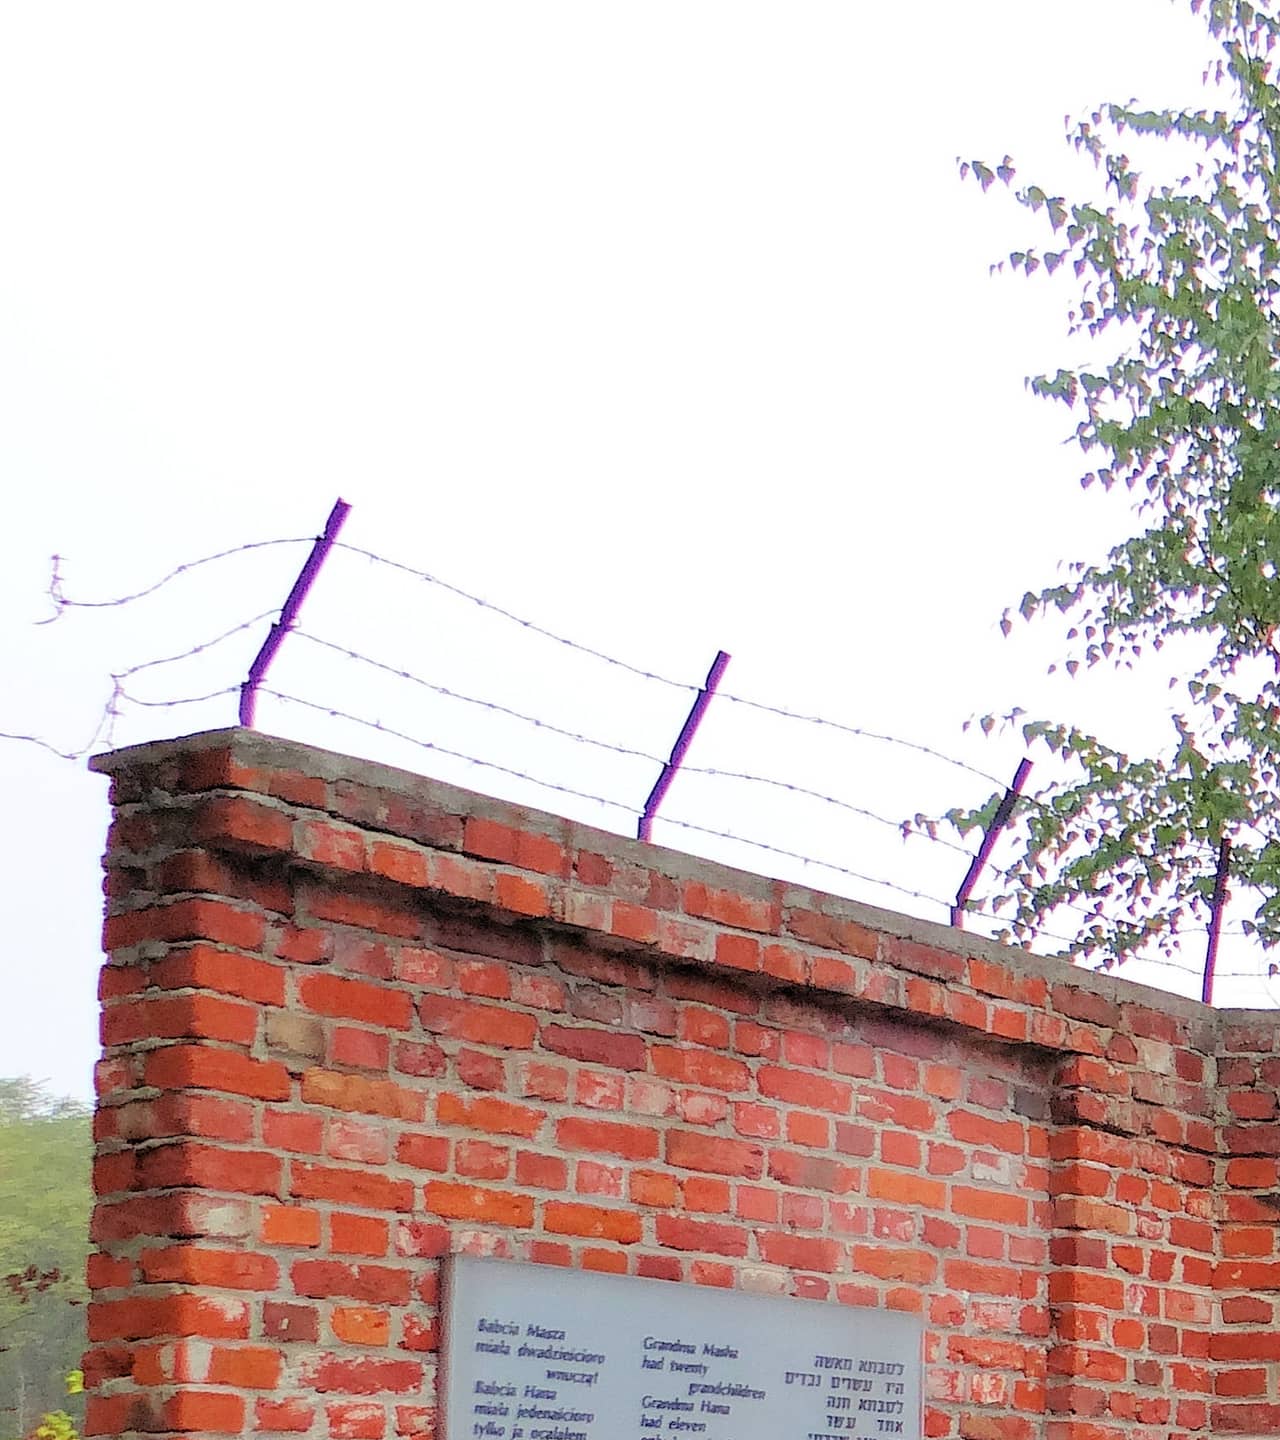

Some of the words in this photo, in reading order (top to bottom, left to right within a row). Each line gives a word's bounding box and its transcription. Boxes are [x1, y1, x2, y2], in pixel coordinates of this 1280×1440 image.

[644, 1337, 696, 1355] Grandma
[641, 1355, 664, 1371] had
[670, 1360, 710, 1377] twenty
[687, 1381, 766, 1400] grandchildren
[641, 1395, 694, 1413] Grandma
[700, 1400, 731, 1415] Hana
[826, 1395, 851, 1410] חנה
[511, 1423, 524, 1440] ja
[640, 1414, 663, 1429] had
[668, 1417, 706, 1433] eleven
[826, 1415, 857, 1430] עשר
[876, 1418, 904, 1434] אחד
